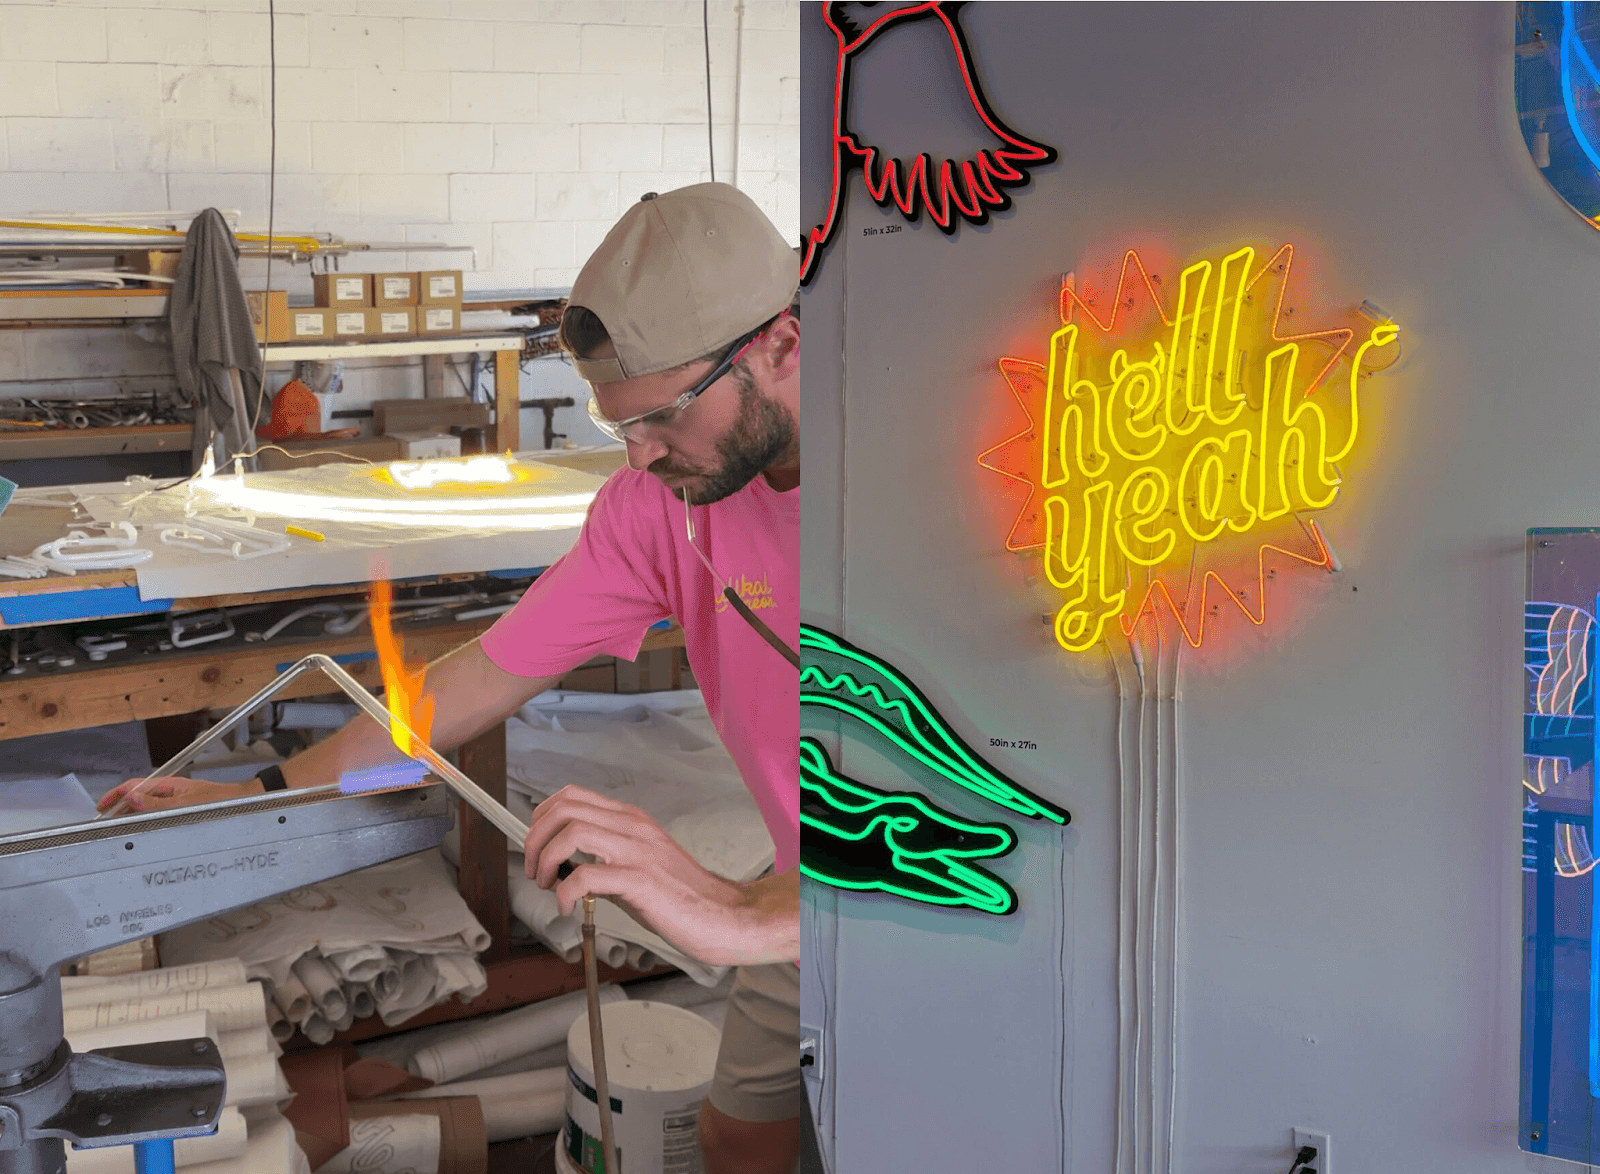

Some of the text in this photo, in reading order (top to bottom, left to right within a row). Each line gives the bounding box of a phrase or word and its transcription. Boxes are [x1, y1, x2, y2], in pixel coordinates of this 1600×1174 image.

[863, 227, 877, 236] 51in
[886, 225, 902, 233] 32in
[1042, 246, 1256, 489] hell
[1044, 324, 1400, 653] yeah
[990, 738, 1008, 748] 50in
[1018, 740, 1037, 749] 27in
